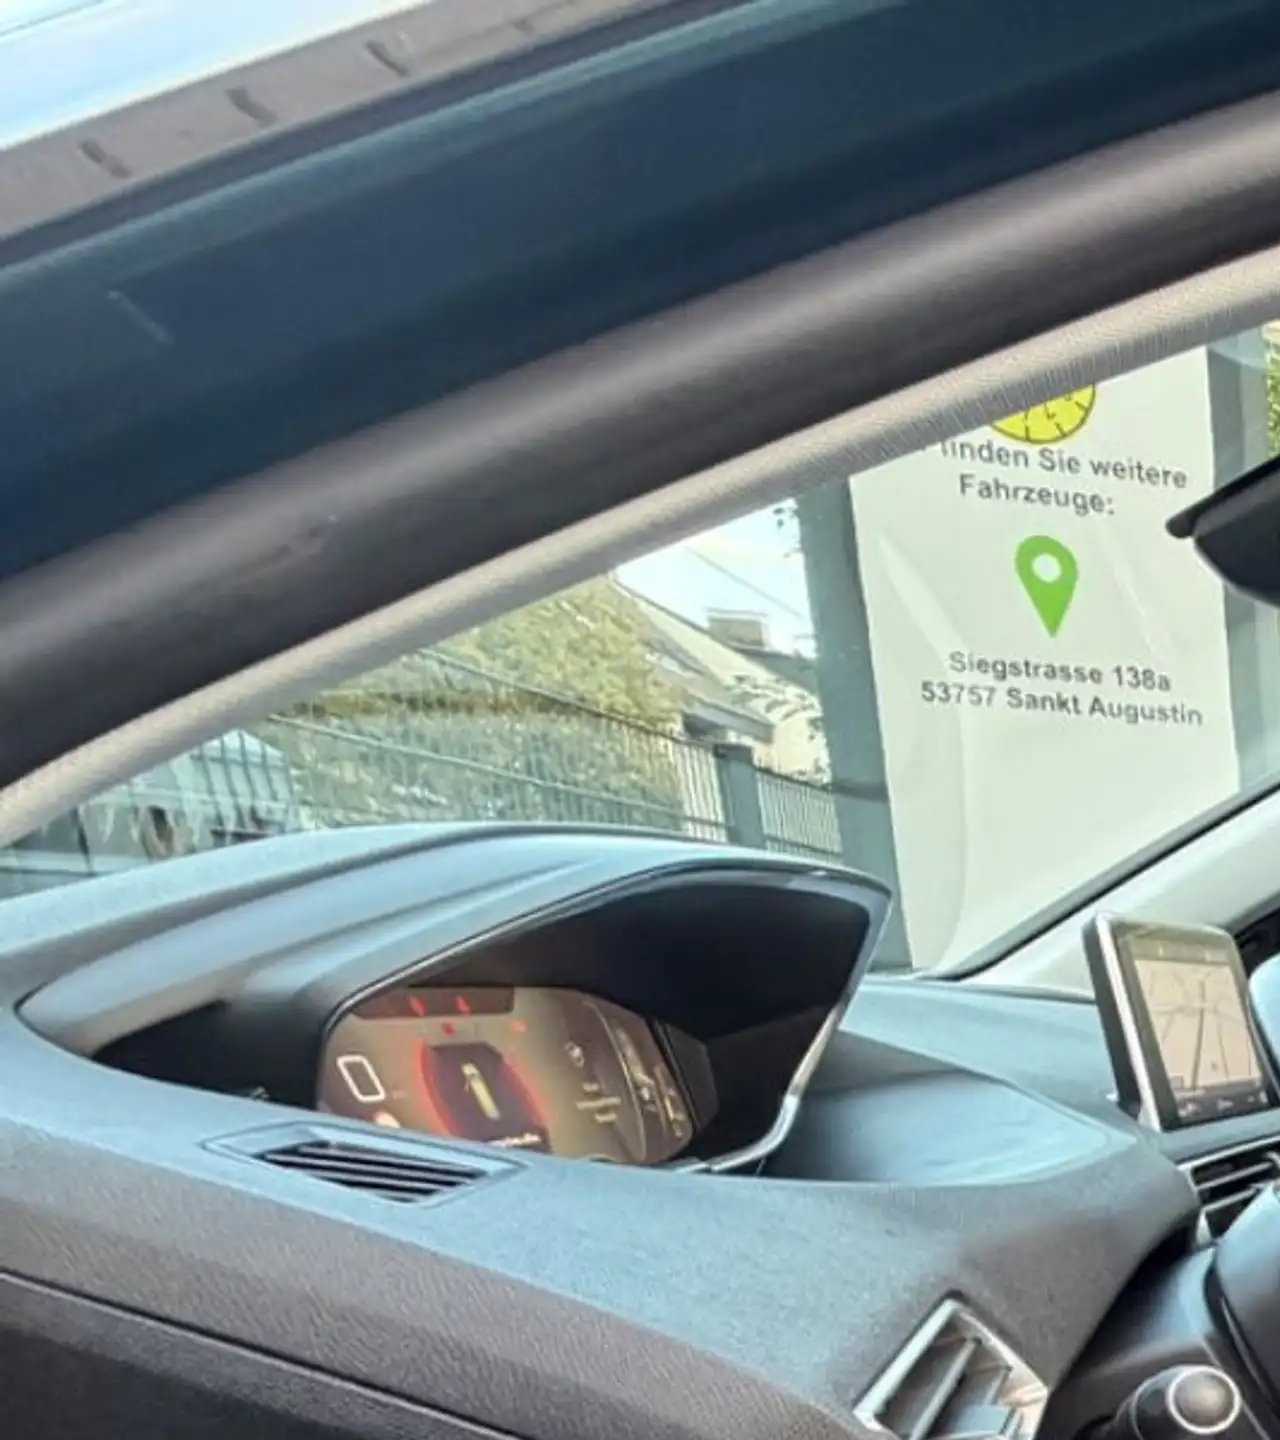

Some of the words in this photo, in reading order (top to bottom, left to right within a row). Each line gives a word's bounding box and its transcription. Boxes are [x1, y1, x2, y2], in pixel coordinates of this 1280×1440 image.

[1038, 446, 1081, 475] Sie
[1088, 455, 1188, 489] weitere
[958, 472, 1115, 517] Fahrzeuge:
[948, 650, 1103, 685] Siegstrasse
[1111, 663, 1172, 692] 138a
[921, 680, 996, 707] 53757
[1006, 685, 1081, 716] Sankt
[1088, 695, 1204, 725] Augustin
